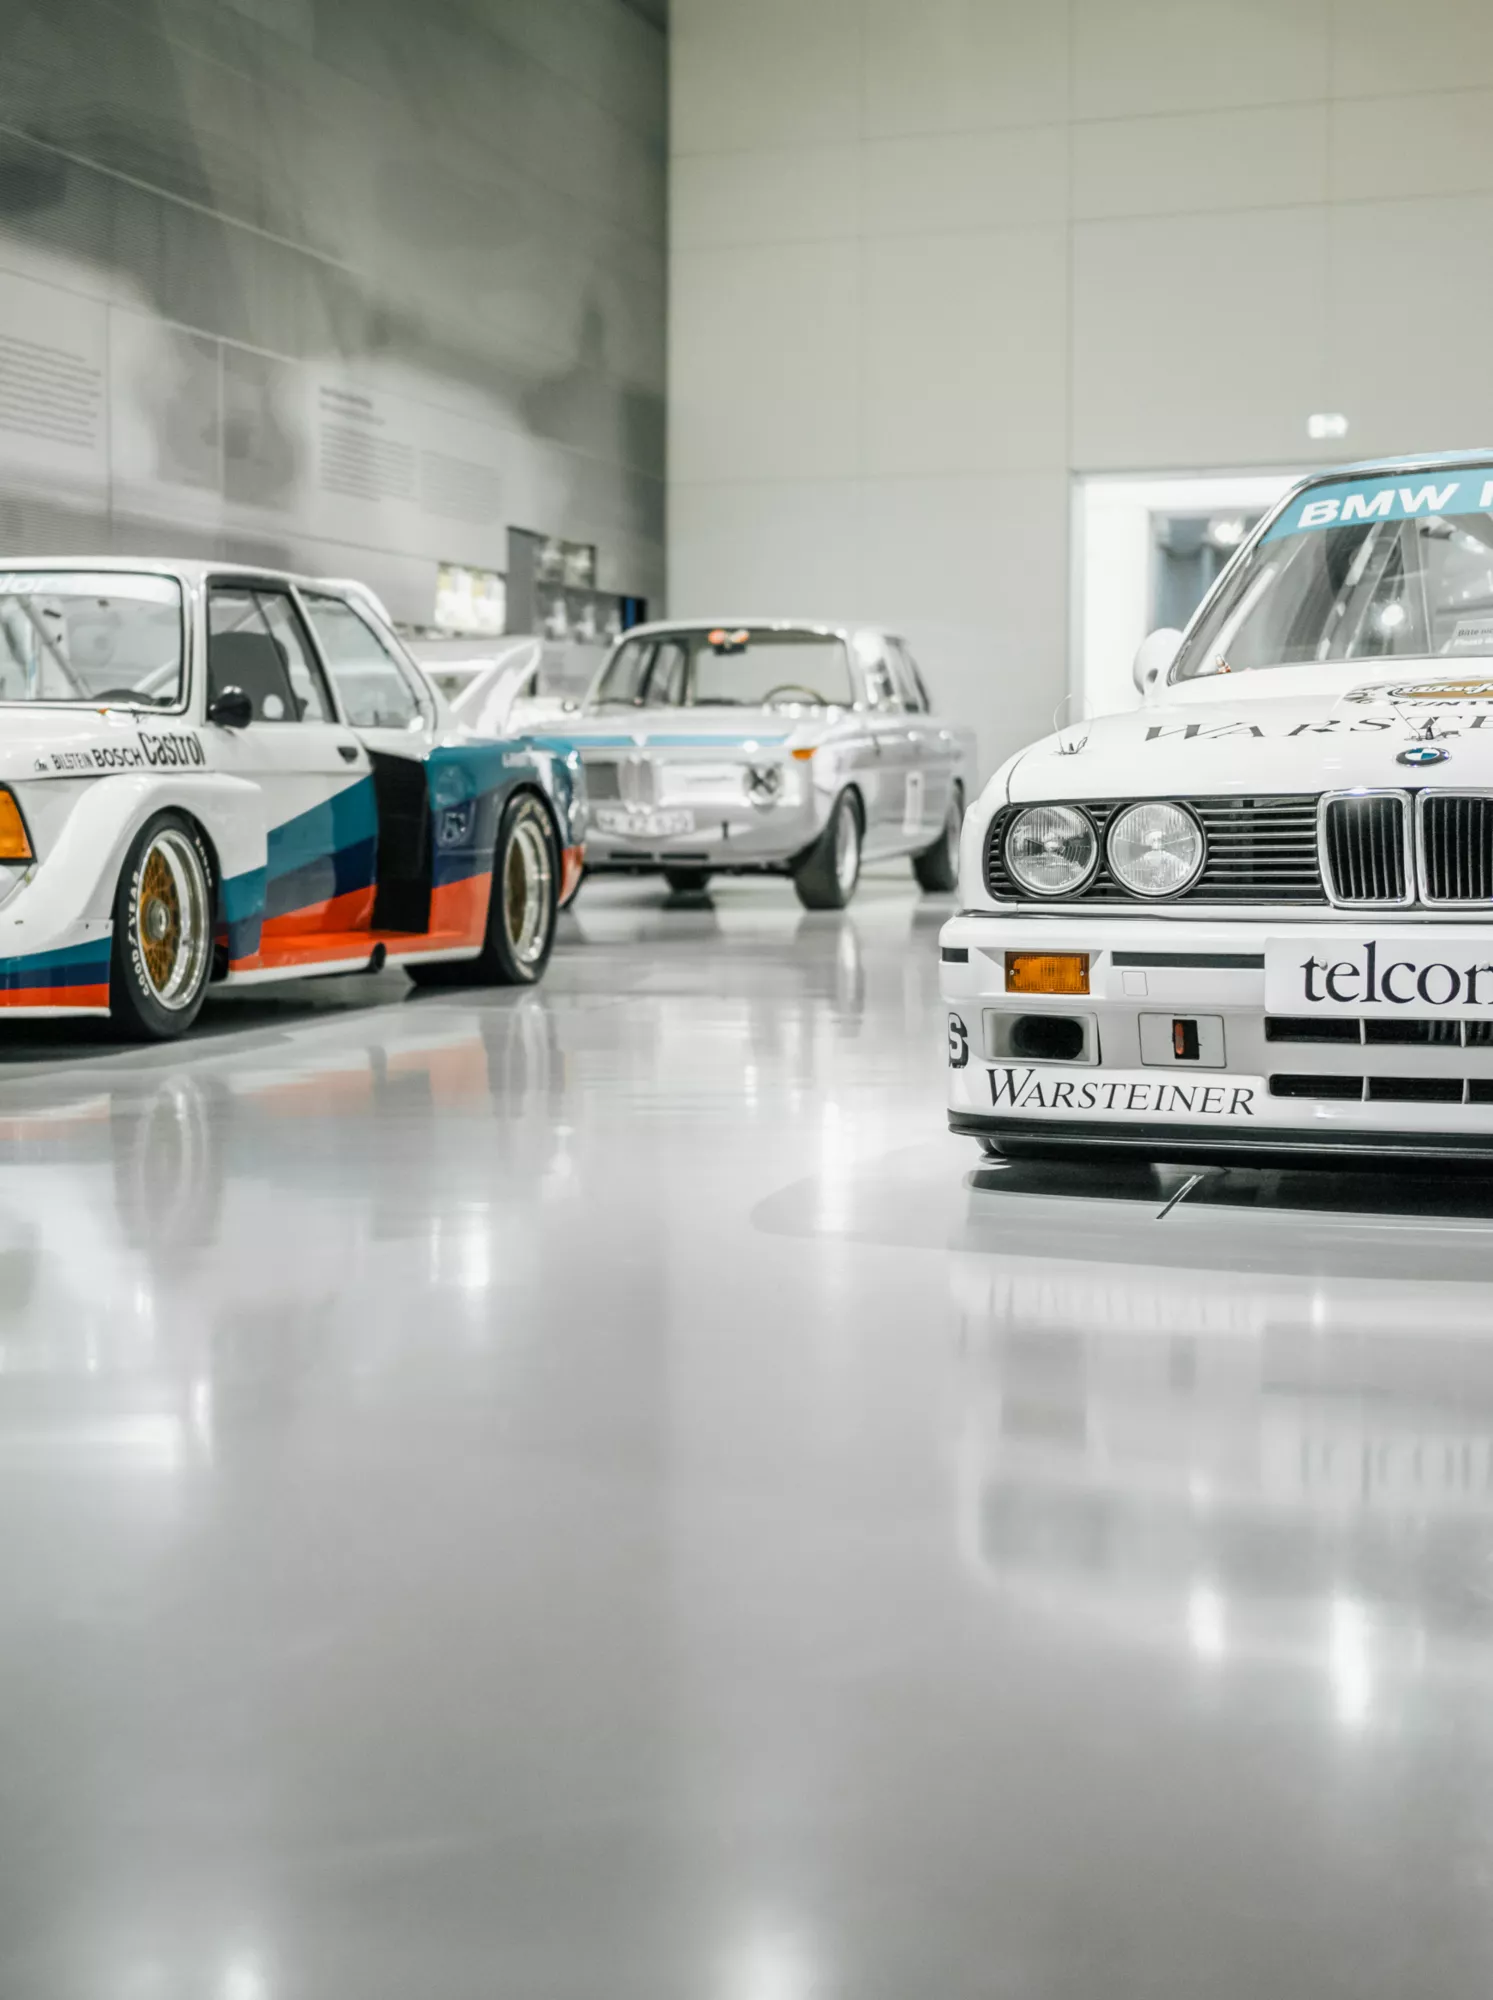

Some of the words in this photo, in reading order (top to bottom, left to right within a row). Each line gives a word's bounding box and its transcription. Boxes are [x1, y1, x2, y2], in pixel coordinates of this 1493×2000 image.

[1297, 483, 1460, 528] BMW
[51, 752, 94, 770] BILSTEIN
[91, 748, 145, 768] BOSCH
[137, 731, 206, 766] Castrol
[985, 1068, 1255, 1116] WARSTEINER
